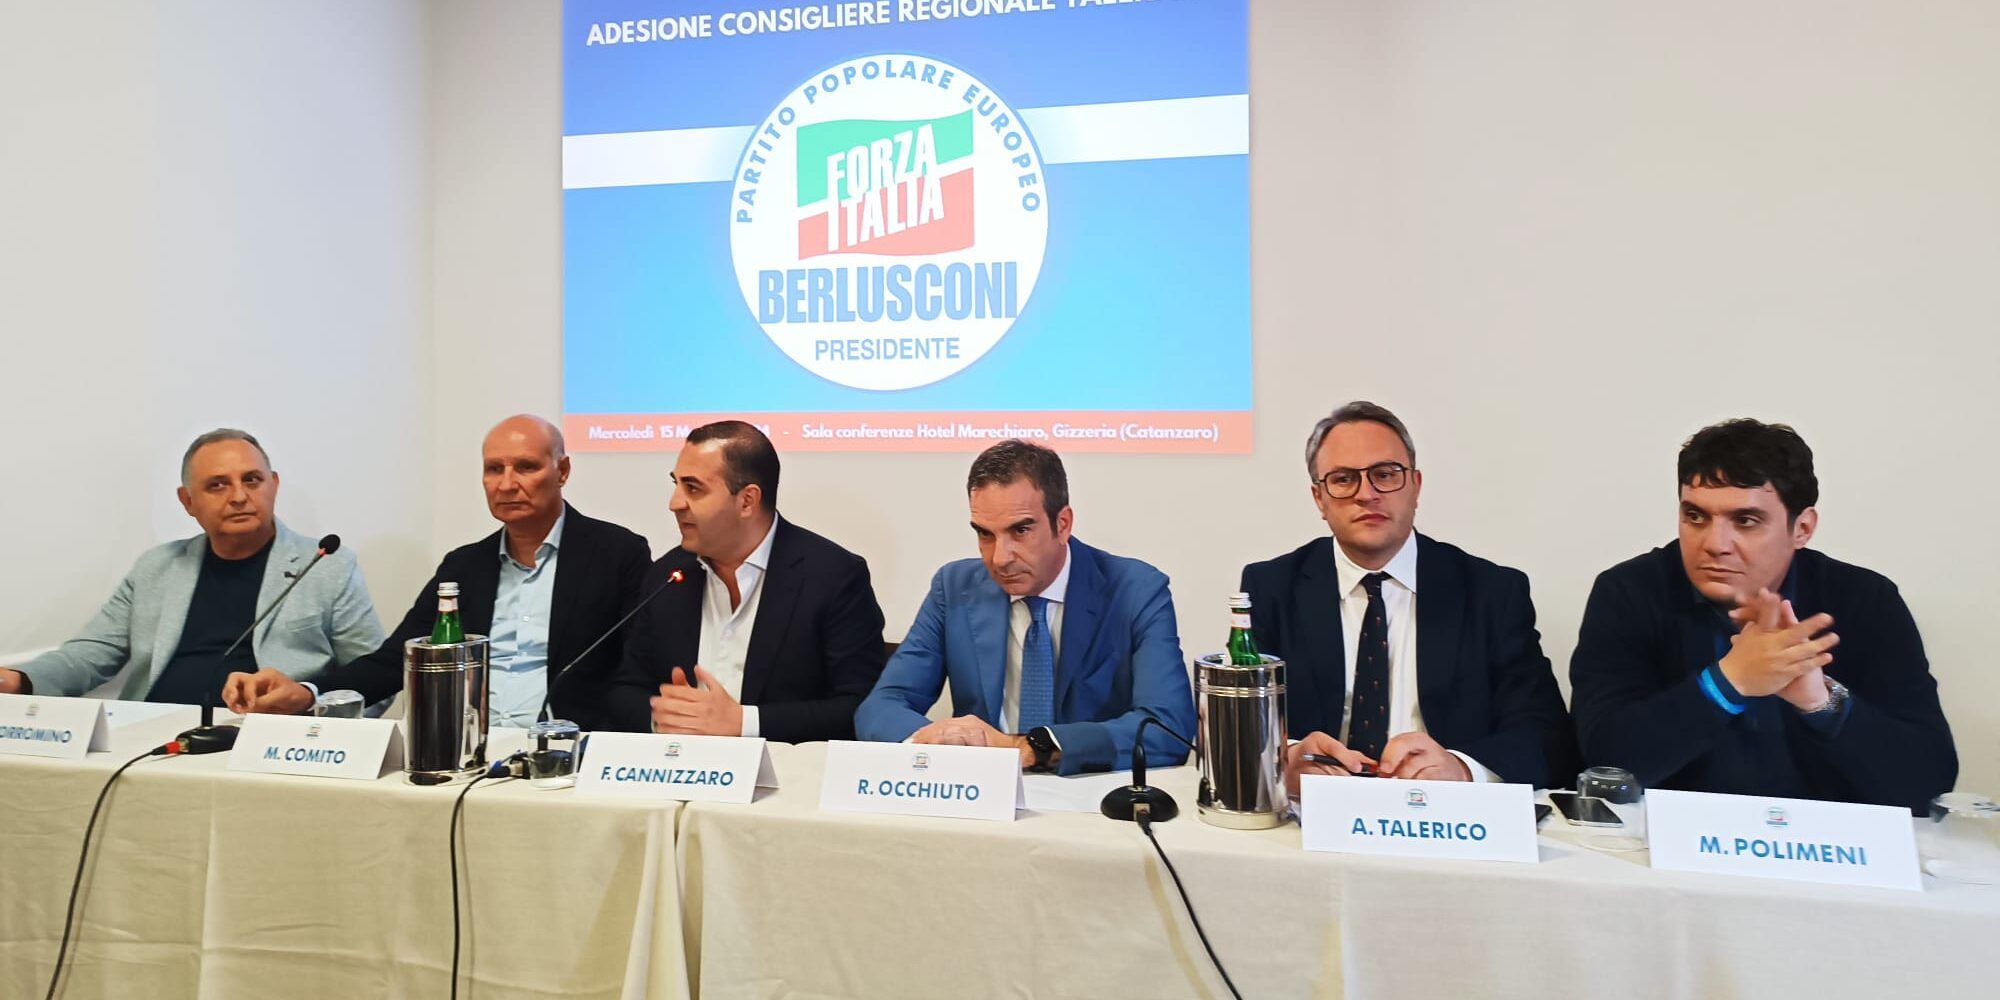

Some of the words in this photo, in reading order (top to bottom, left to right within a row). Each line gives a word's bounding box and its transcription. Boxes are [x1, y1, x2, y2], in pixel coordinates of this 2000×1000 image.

[586, 15, 712, 46] ADESIONE
[718, 1, 891, 36] CONSIGLIERE
[736, 106, 796, 223] PARTITO
[803, 59, 954, 104] POPOLARE
[962, 84, 1041, 213] EUROPEO
[827, 122, 938, 202] FORZA
[827, 170, 945, 253] ITALIA
[758, 261, 1018, 324] BERLUSCONI
[815, 337, 960, 361] PRESIDENTE
[660, 425, 674, 438] 15
[802, 424, 833, 438] Sala
[835, 424, 913, 438] conferenze
[916, 424, 955, 438] Hotel
[959, 423, 1049, 440] Marechiaro,
[1052, 423, 1117, 438] Gizzeria
[1119, 423, 1219, 441] (Catanzaro)
[264, 747, 281, 760] M.
[285, 747, 346, 764] COMITO
[601, 766, 611, 780] F.
[615, 767, 734, 786] CANNIZZARO
[858, 779, 874, 795] R.
[879, 781, 980, 801] OCCHIUTO
[1352, 817, 1373, 835] A.
[1378, 818, 1487, 841] TALERICO
[1700, 835, 1728, 855] M.
[1734, 837, 1868, 866] POLIMENI
